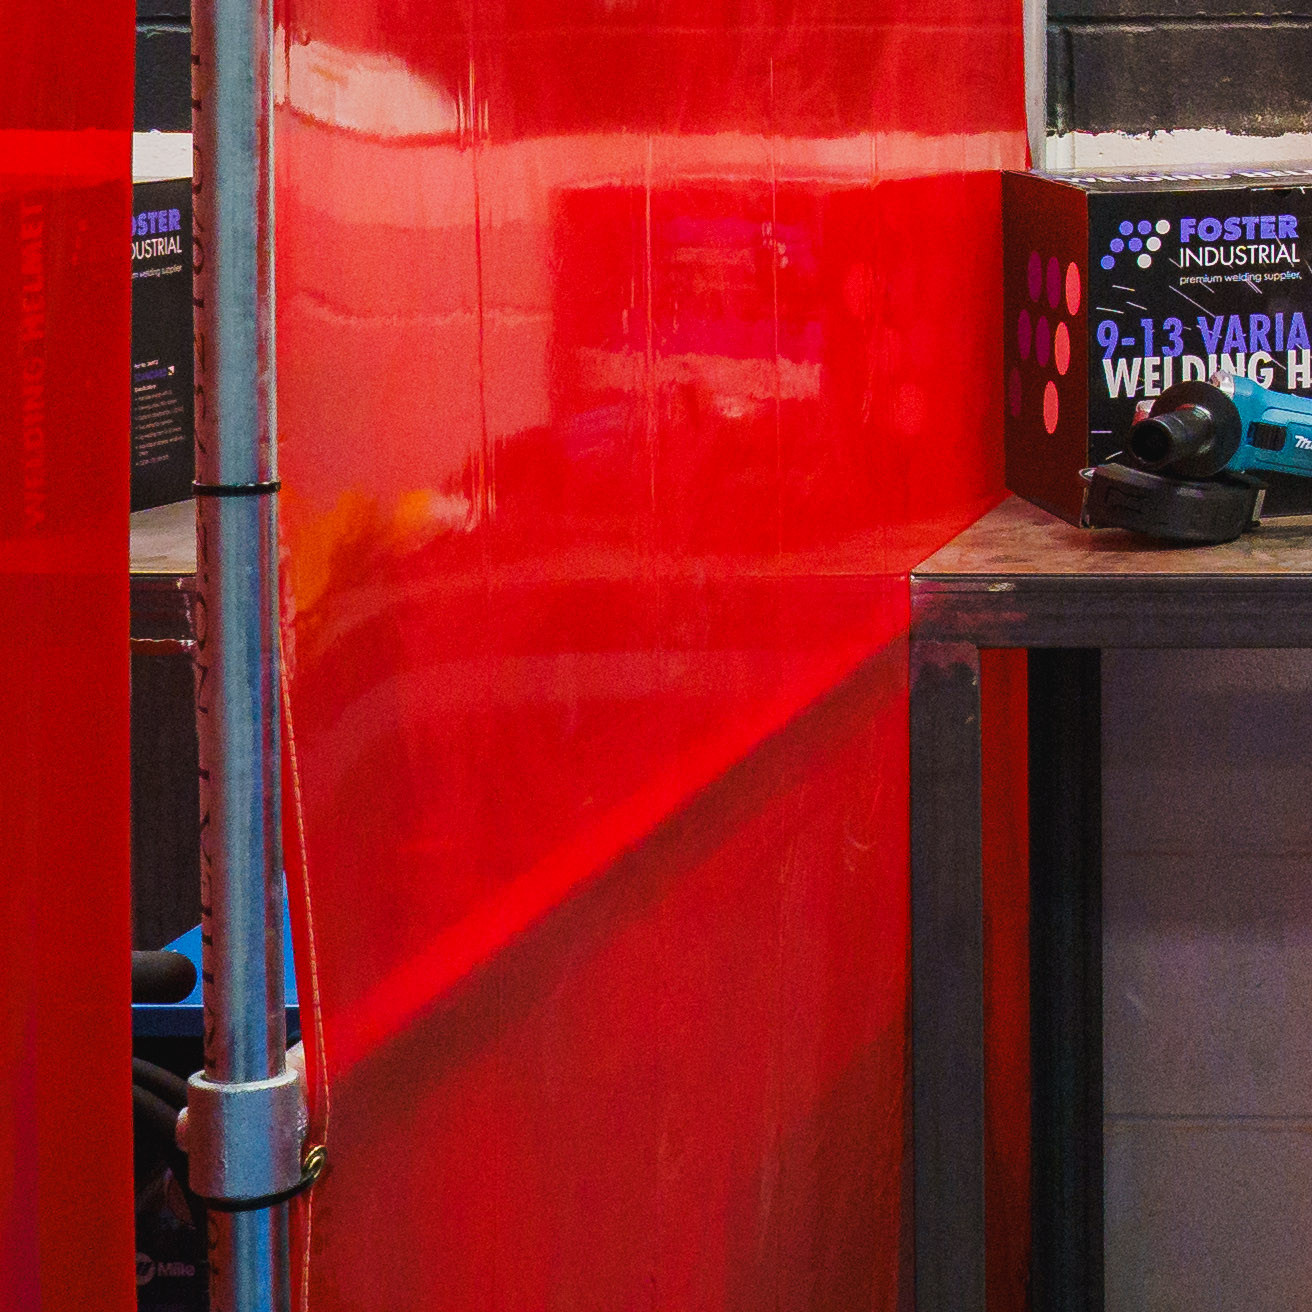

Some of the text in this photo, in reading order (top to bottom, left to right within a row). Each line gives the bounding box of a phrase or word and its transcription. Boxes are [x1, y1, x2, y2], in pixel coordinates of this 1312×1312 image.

[1180, 214, 1299, 243] FOSTER
[1180, 243, 1300, 268] INDUSTRIAL
[1179, 274, 1222, 286] premium
[1224, 272, 1262, 283] welding
[1096, 317, 1184, 360] 9-13
